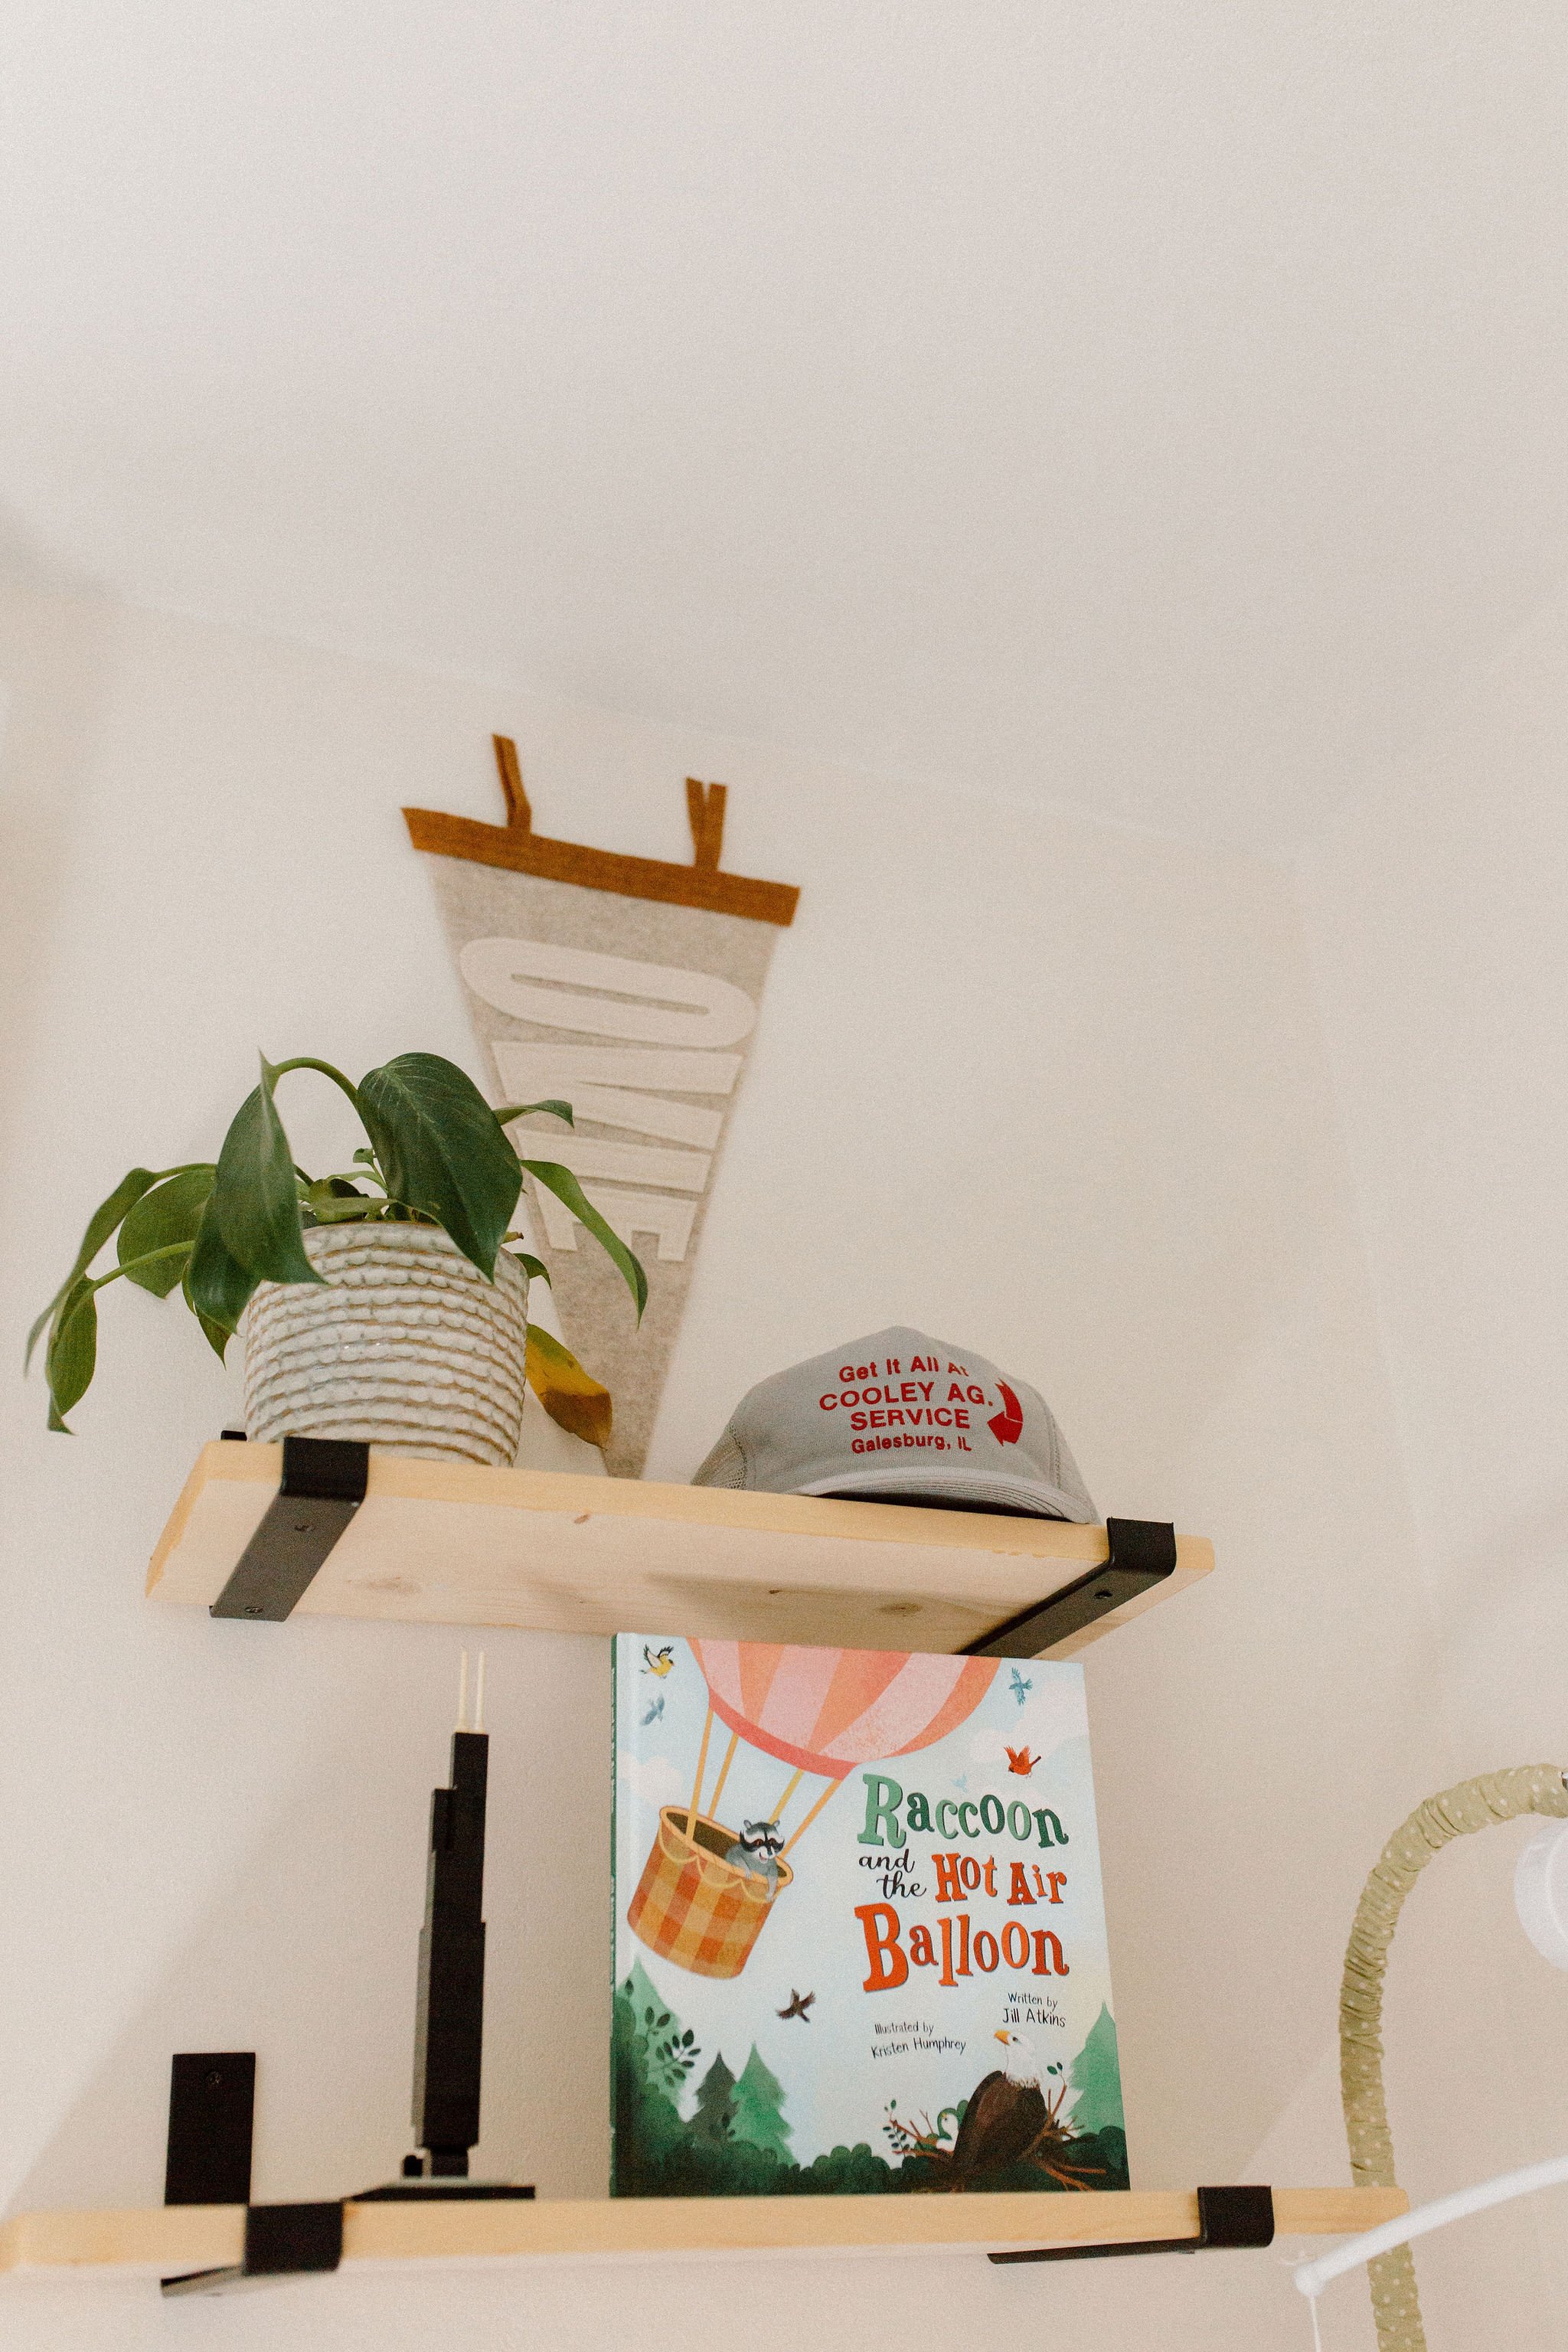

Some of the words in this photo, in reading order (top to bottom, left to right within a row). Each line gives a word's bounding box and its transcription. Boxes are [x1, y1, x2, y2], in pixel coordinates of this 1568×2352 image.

[459, 937, 756, 1262] ONE
[839, 1361, 878, 1382] Get
[886, 1358, 901, 1375] It
[910, 1356, 939, 1372] All
[819, 1382, 935, 1410] COOLEY
[947, 1383, 994, 1406] AG.
[851, 1408, 971, 1430] SERVICE
[851, 1433, 951, 1454] Galesburg,
[958, 1436, 972, 1452] IL
[858, 1773, 1070, 1848] Raccoon
[858, 1849, 916, 1873] and
[876, 1870, 926, 1899] the
[931, 1853, 998, 1903] Hot
[1007, 1862, 1067, 1905] Air
[854, 1903, 1070, 1992] Balloon
[1008, 1992, 1042, 2005] Written
[1047, 1996, 1058, 2011] by
[874, 2021, 919, 2034] Illustrated
[923, 2022, 934, 2037] by
[1002, 2008, 1020, 2024] Jill
[1026, 2009, 1067, 2027] Atkins
[871, 2042, 909, 2059] Kristen
[913, 2037, 966, 2055] Humphrey
